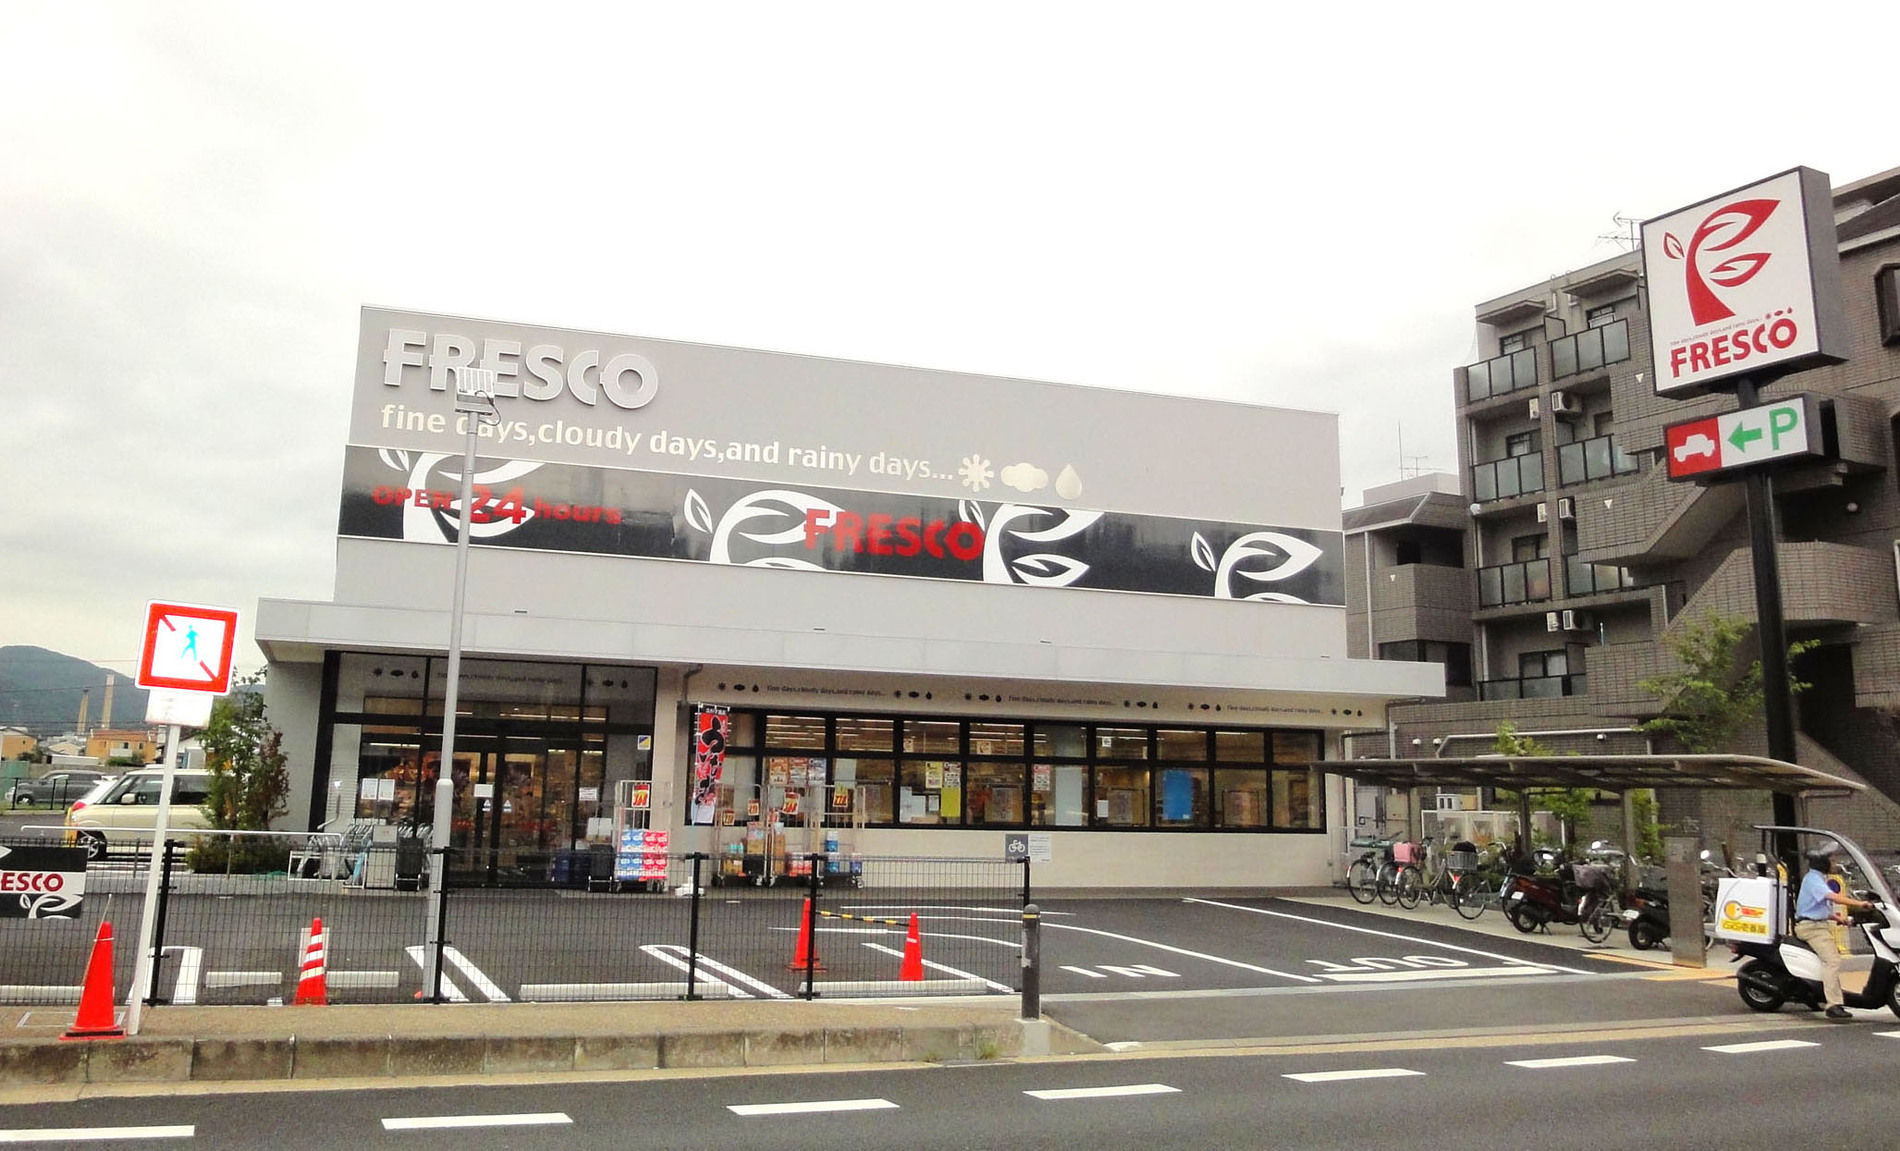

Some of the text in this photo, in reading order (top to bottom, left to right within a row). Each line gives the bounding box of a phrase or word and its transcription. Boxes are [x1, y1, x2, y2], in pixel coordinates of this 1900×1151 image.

[383, 328, 659, 410] FRESCO
[1670, 317, 1797, 378] FRESCO
[381, 404, 446, 433] fine
[788, 446, 862, 475] rainy
[870, 451, 954, 481] days...
[1769, 407, 1798, 450] P
[372, 484, 622, 525] OPEN 24 hours
[804, 507, 984, 561] FRESCO
[1058, 963, 1182, 978] IN
[1307, 955, 1469, 973] OUT
